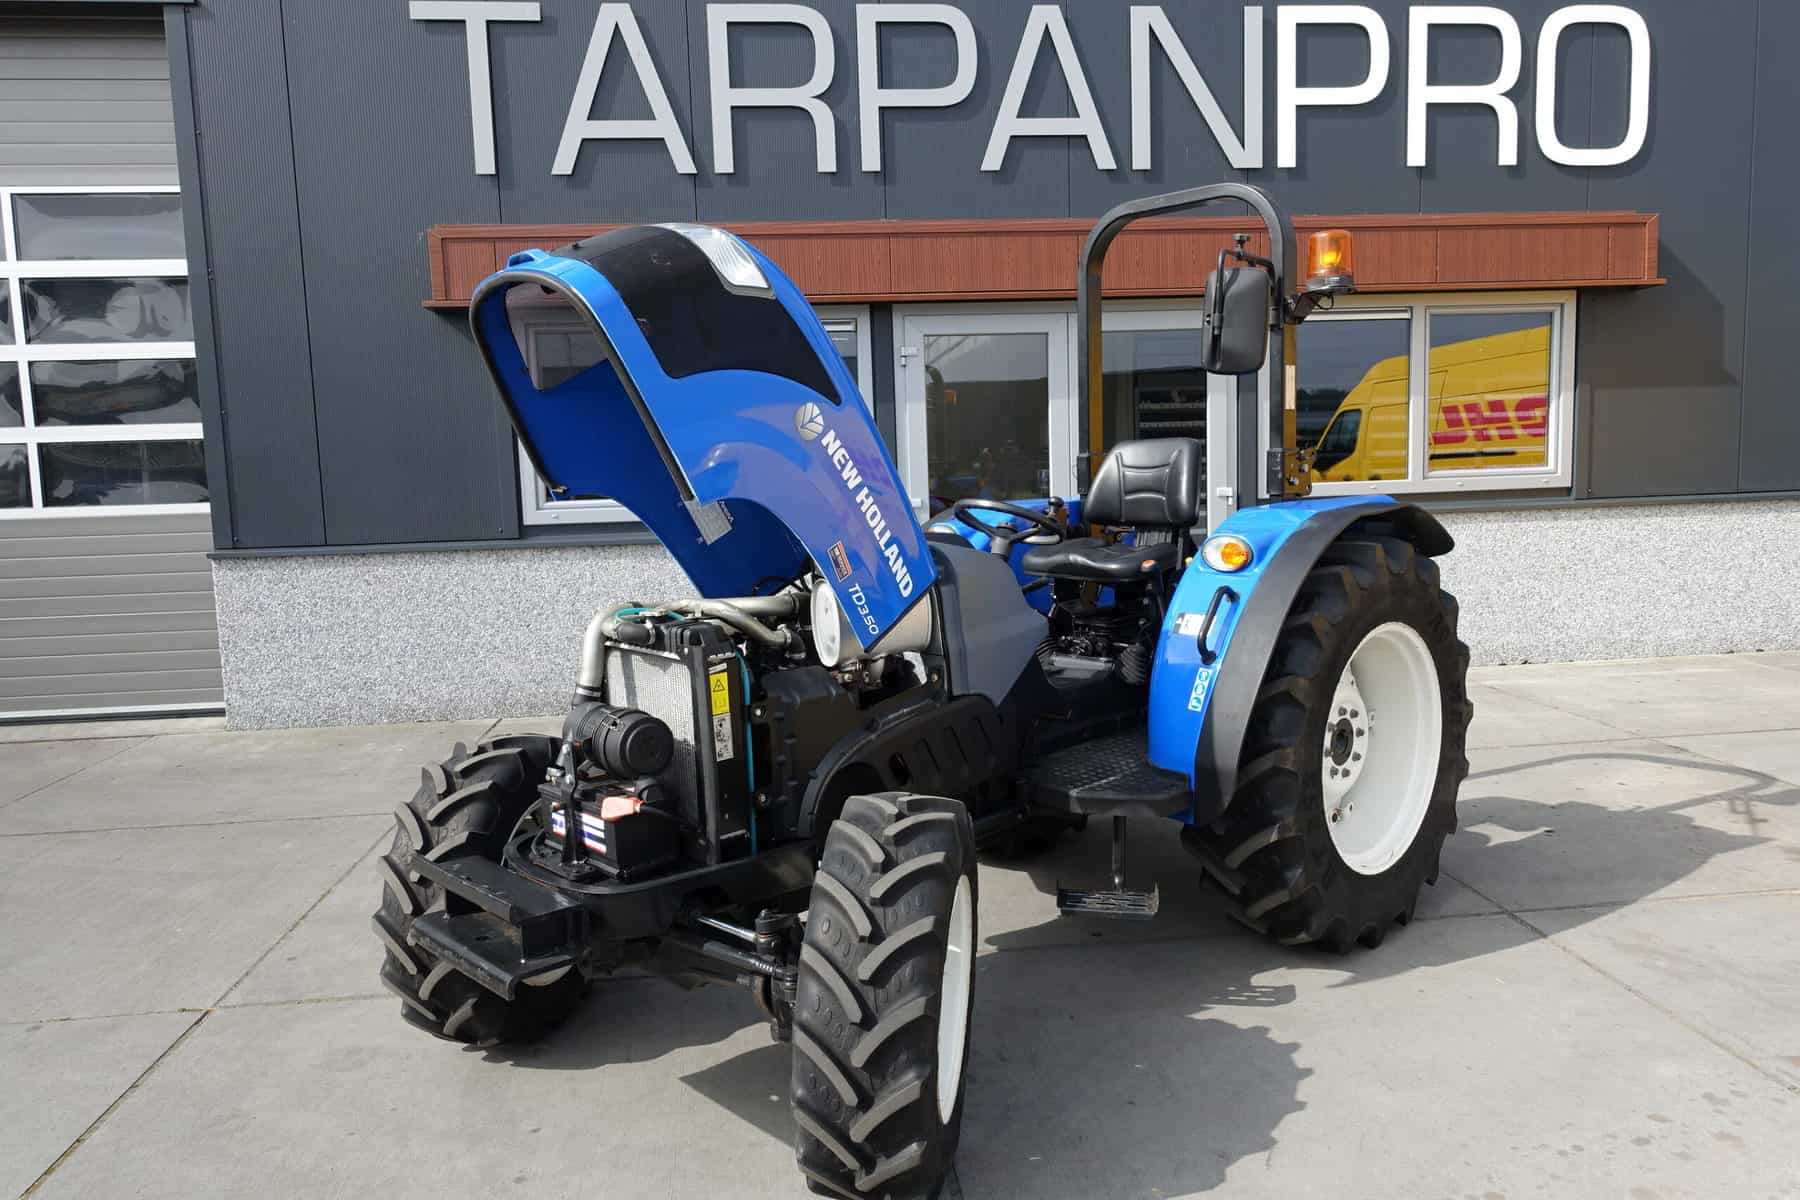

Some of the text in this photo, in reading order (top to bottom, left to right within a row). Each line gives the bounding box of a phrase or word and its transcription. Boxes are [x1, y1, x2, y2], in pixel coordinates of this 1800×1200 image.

[409, 0, 1651, 176] TARPANPRO
[821, 429, 862, 490] NEW
[856, 487, 913, 598] HOLLAND
